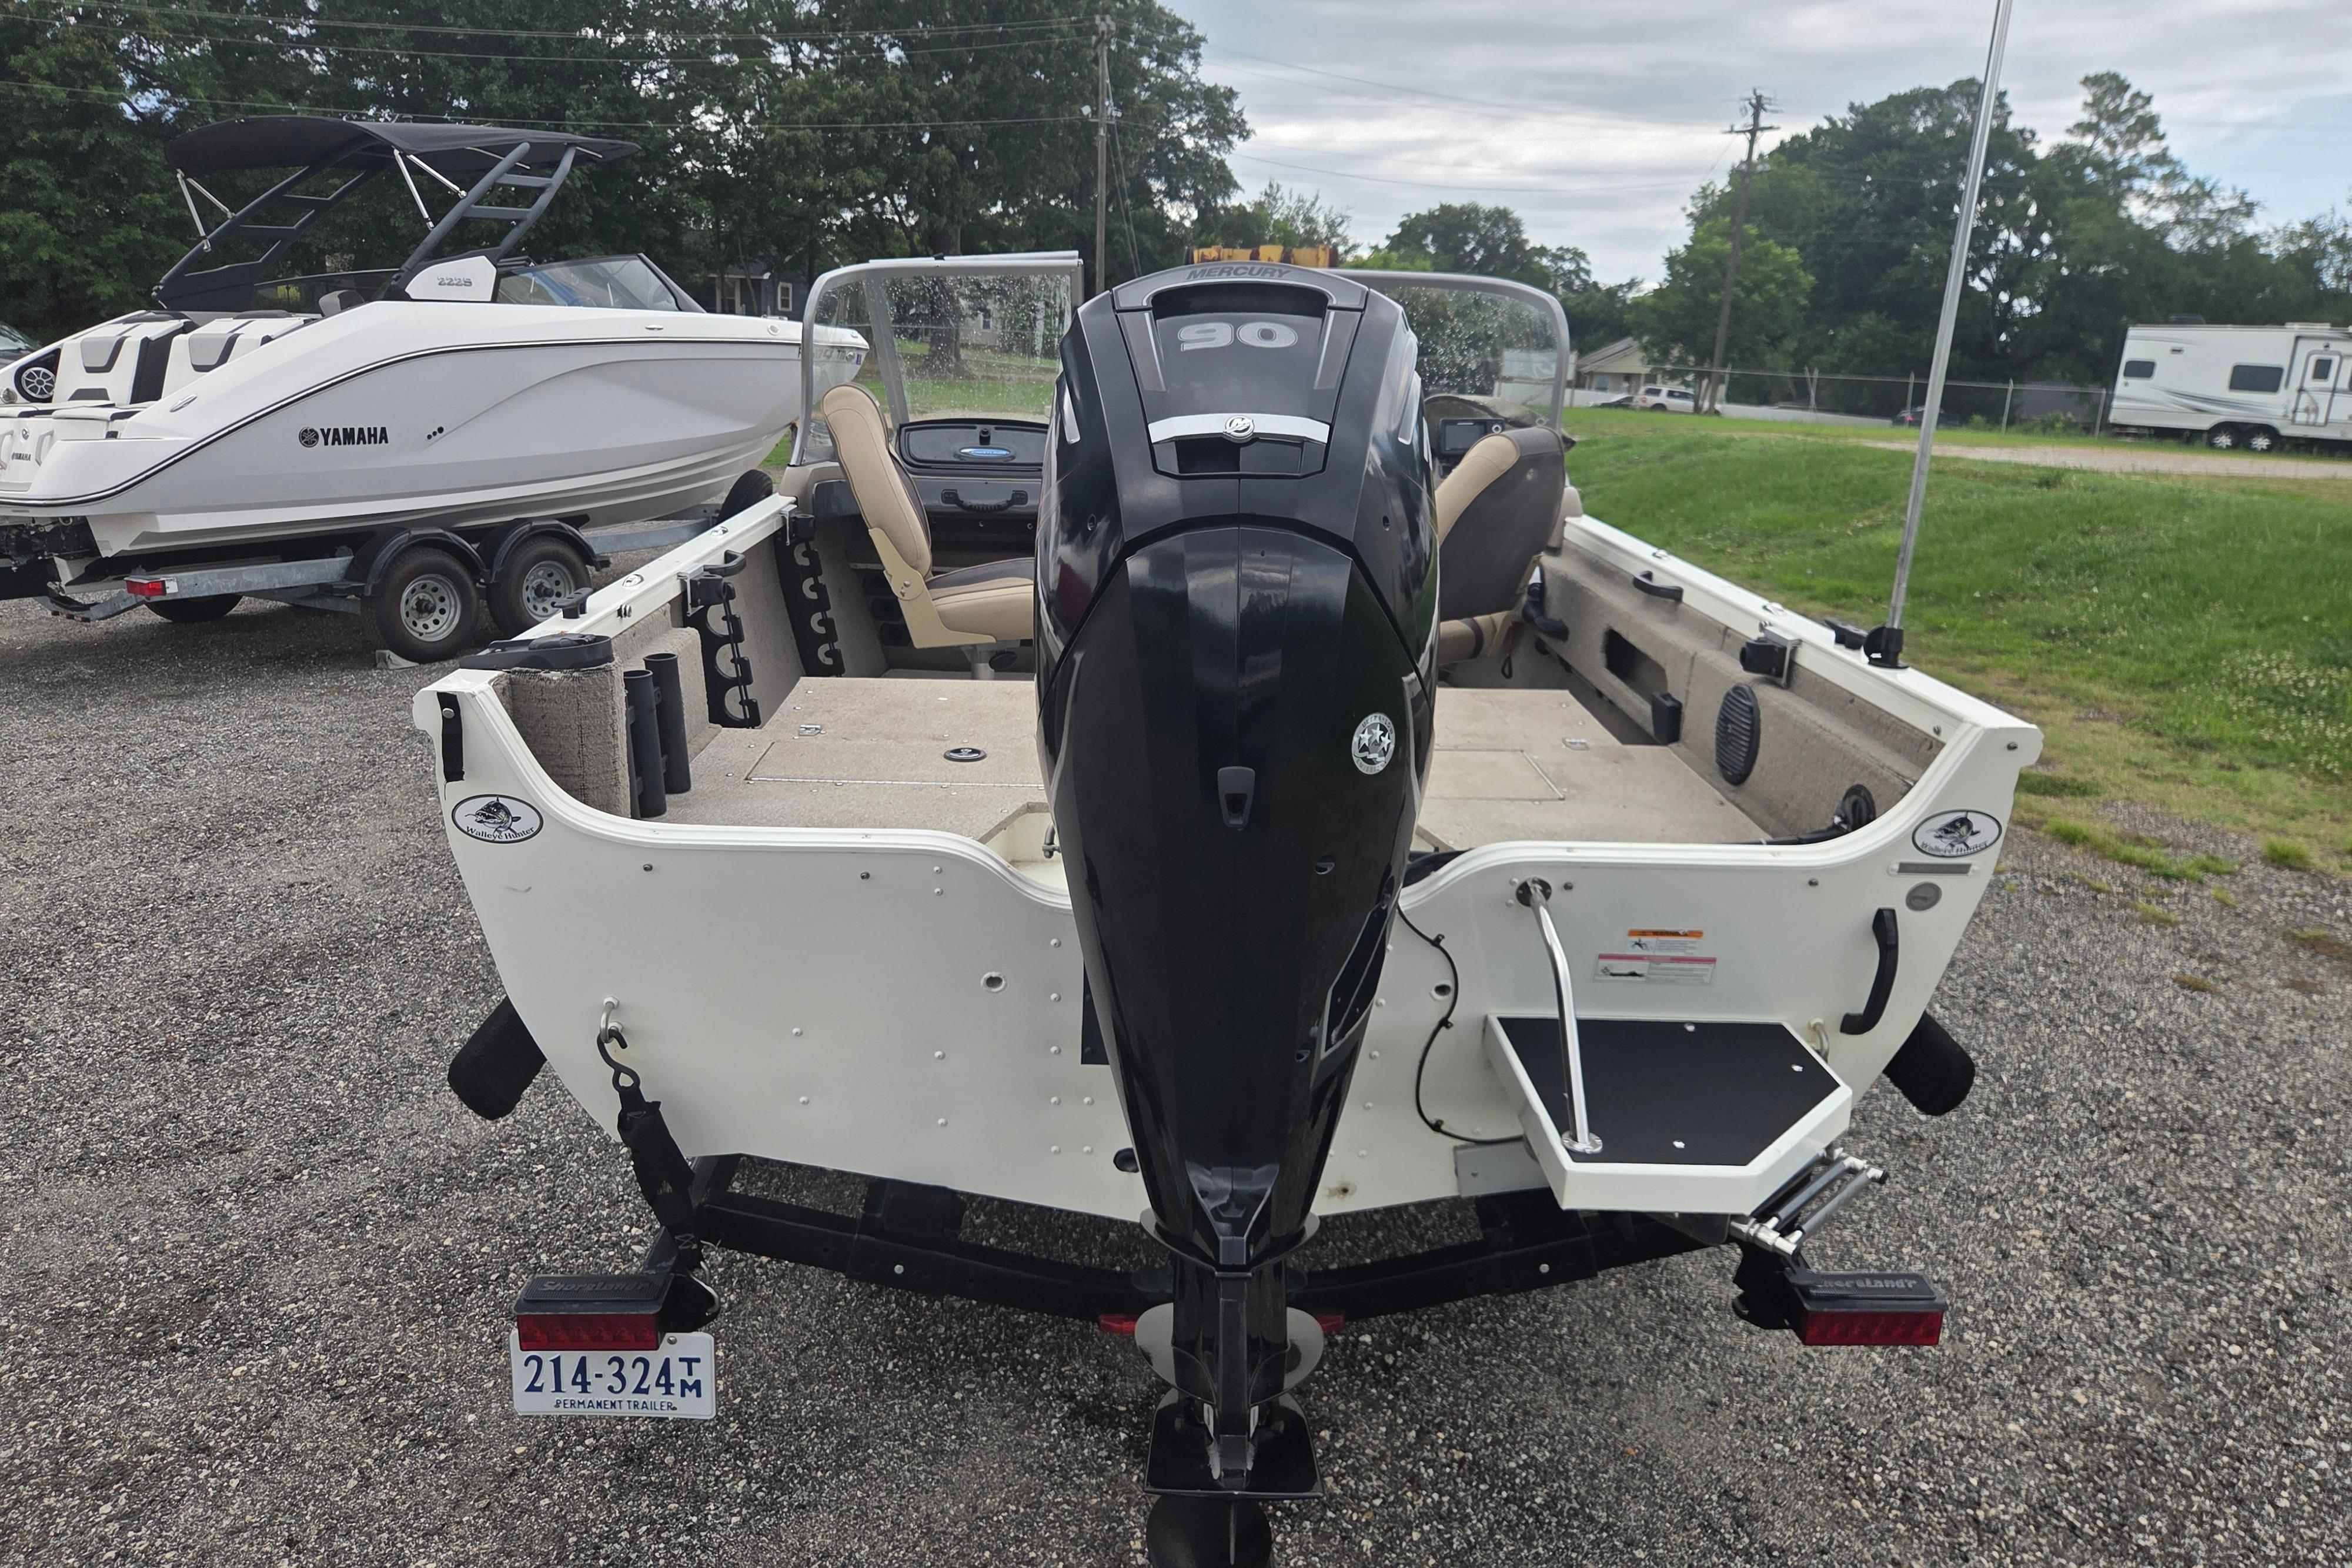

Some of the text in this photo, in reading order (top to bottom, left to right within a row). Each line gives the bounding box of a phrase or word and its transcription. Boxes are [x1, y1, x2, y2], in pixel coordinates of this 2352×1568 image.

[1185, 266, 1292, 280] MERCURY
[1177, 322, 1298, 352] 90
[320, 426, 389, 446] YAMAHA
[466, 825, 534, 841] Walleye Hunter
[523, 1354, 675, 1396] 214-324
[554, 1399, 674, 1411] PERMANENT TRAILER
